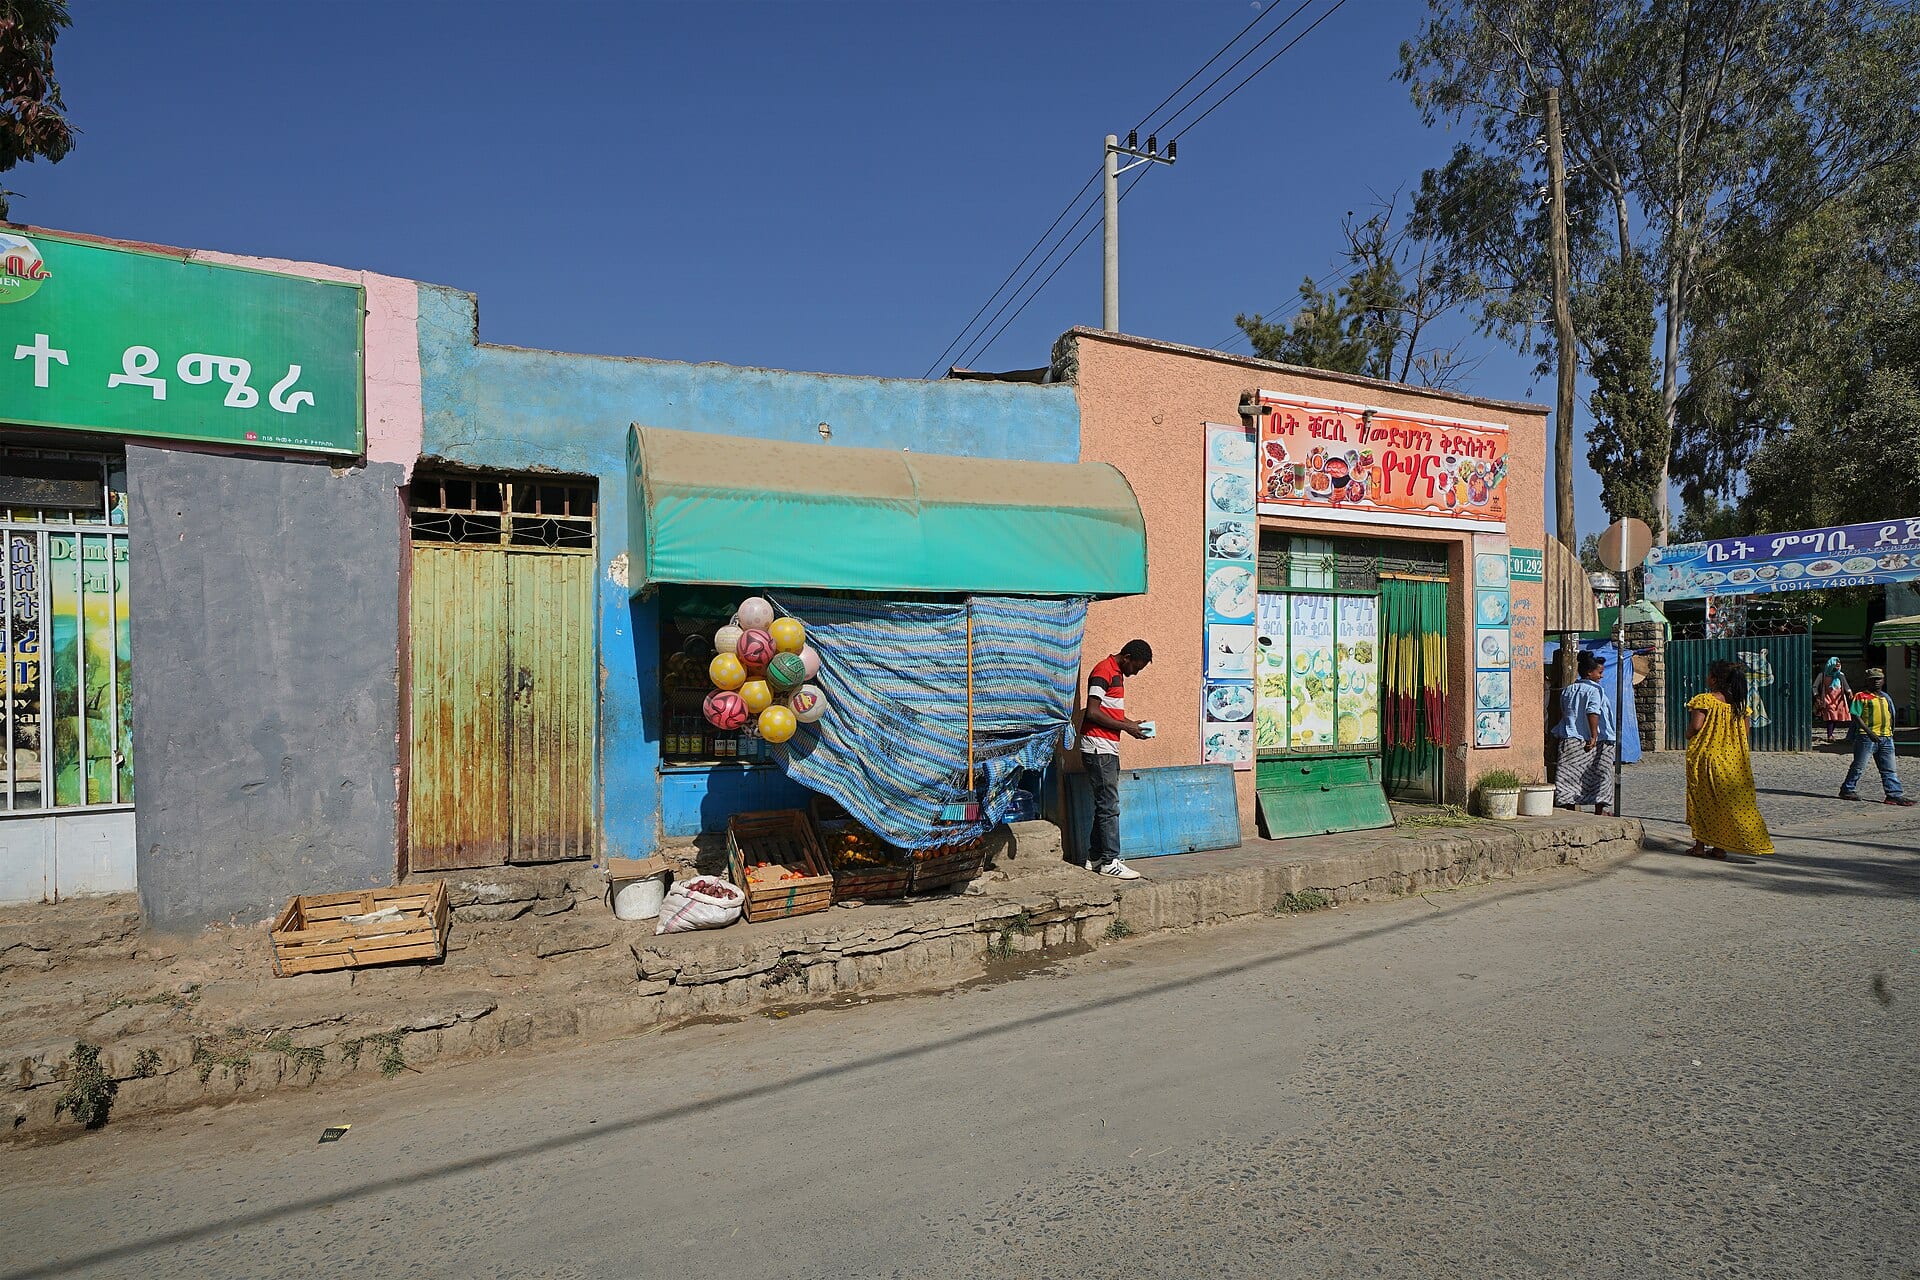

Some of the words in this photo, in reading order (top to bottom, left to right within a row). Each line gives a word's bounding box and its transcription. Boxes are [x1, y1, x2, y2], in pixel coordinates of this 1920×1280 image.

[1270, 412, 1300, 435] ቤት
[1707, 541, 1754, 562] ቤት
[1771, 531, 1855, 556] ምግቢ
[1780, 576, 1875, 592] 0914-748043
